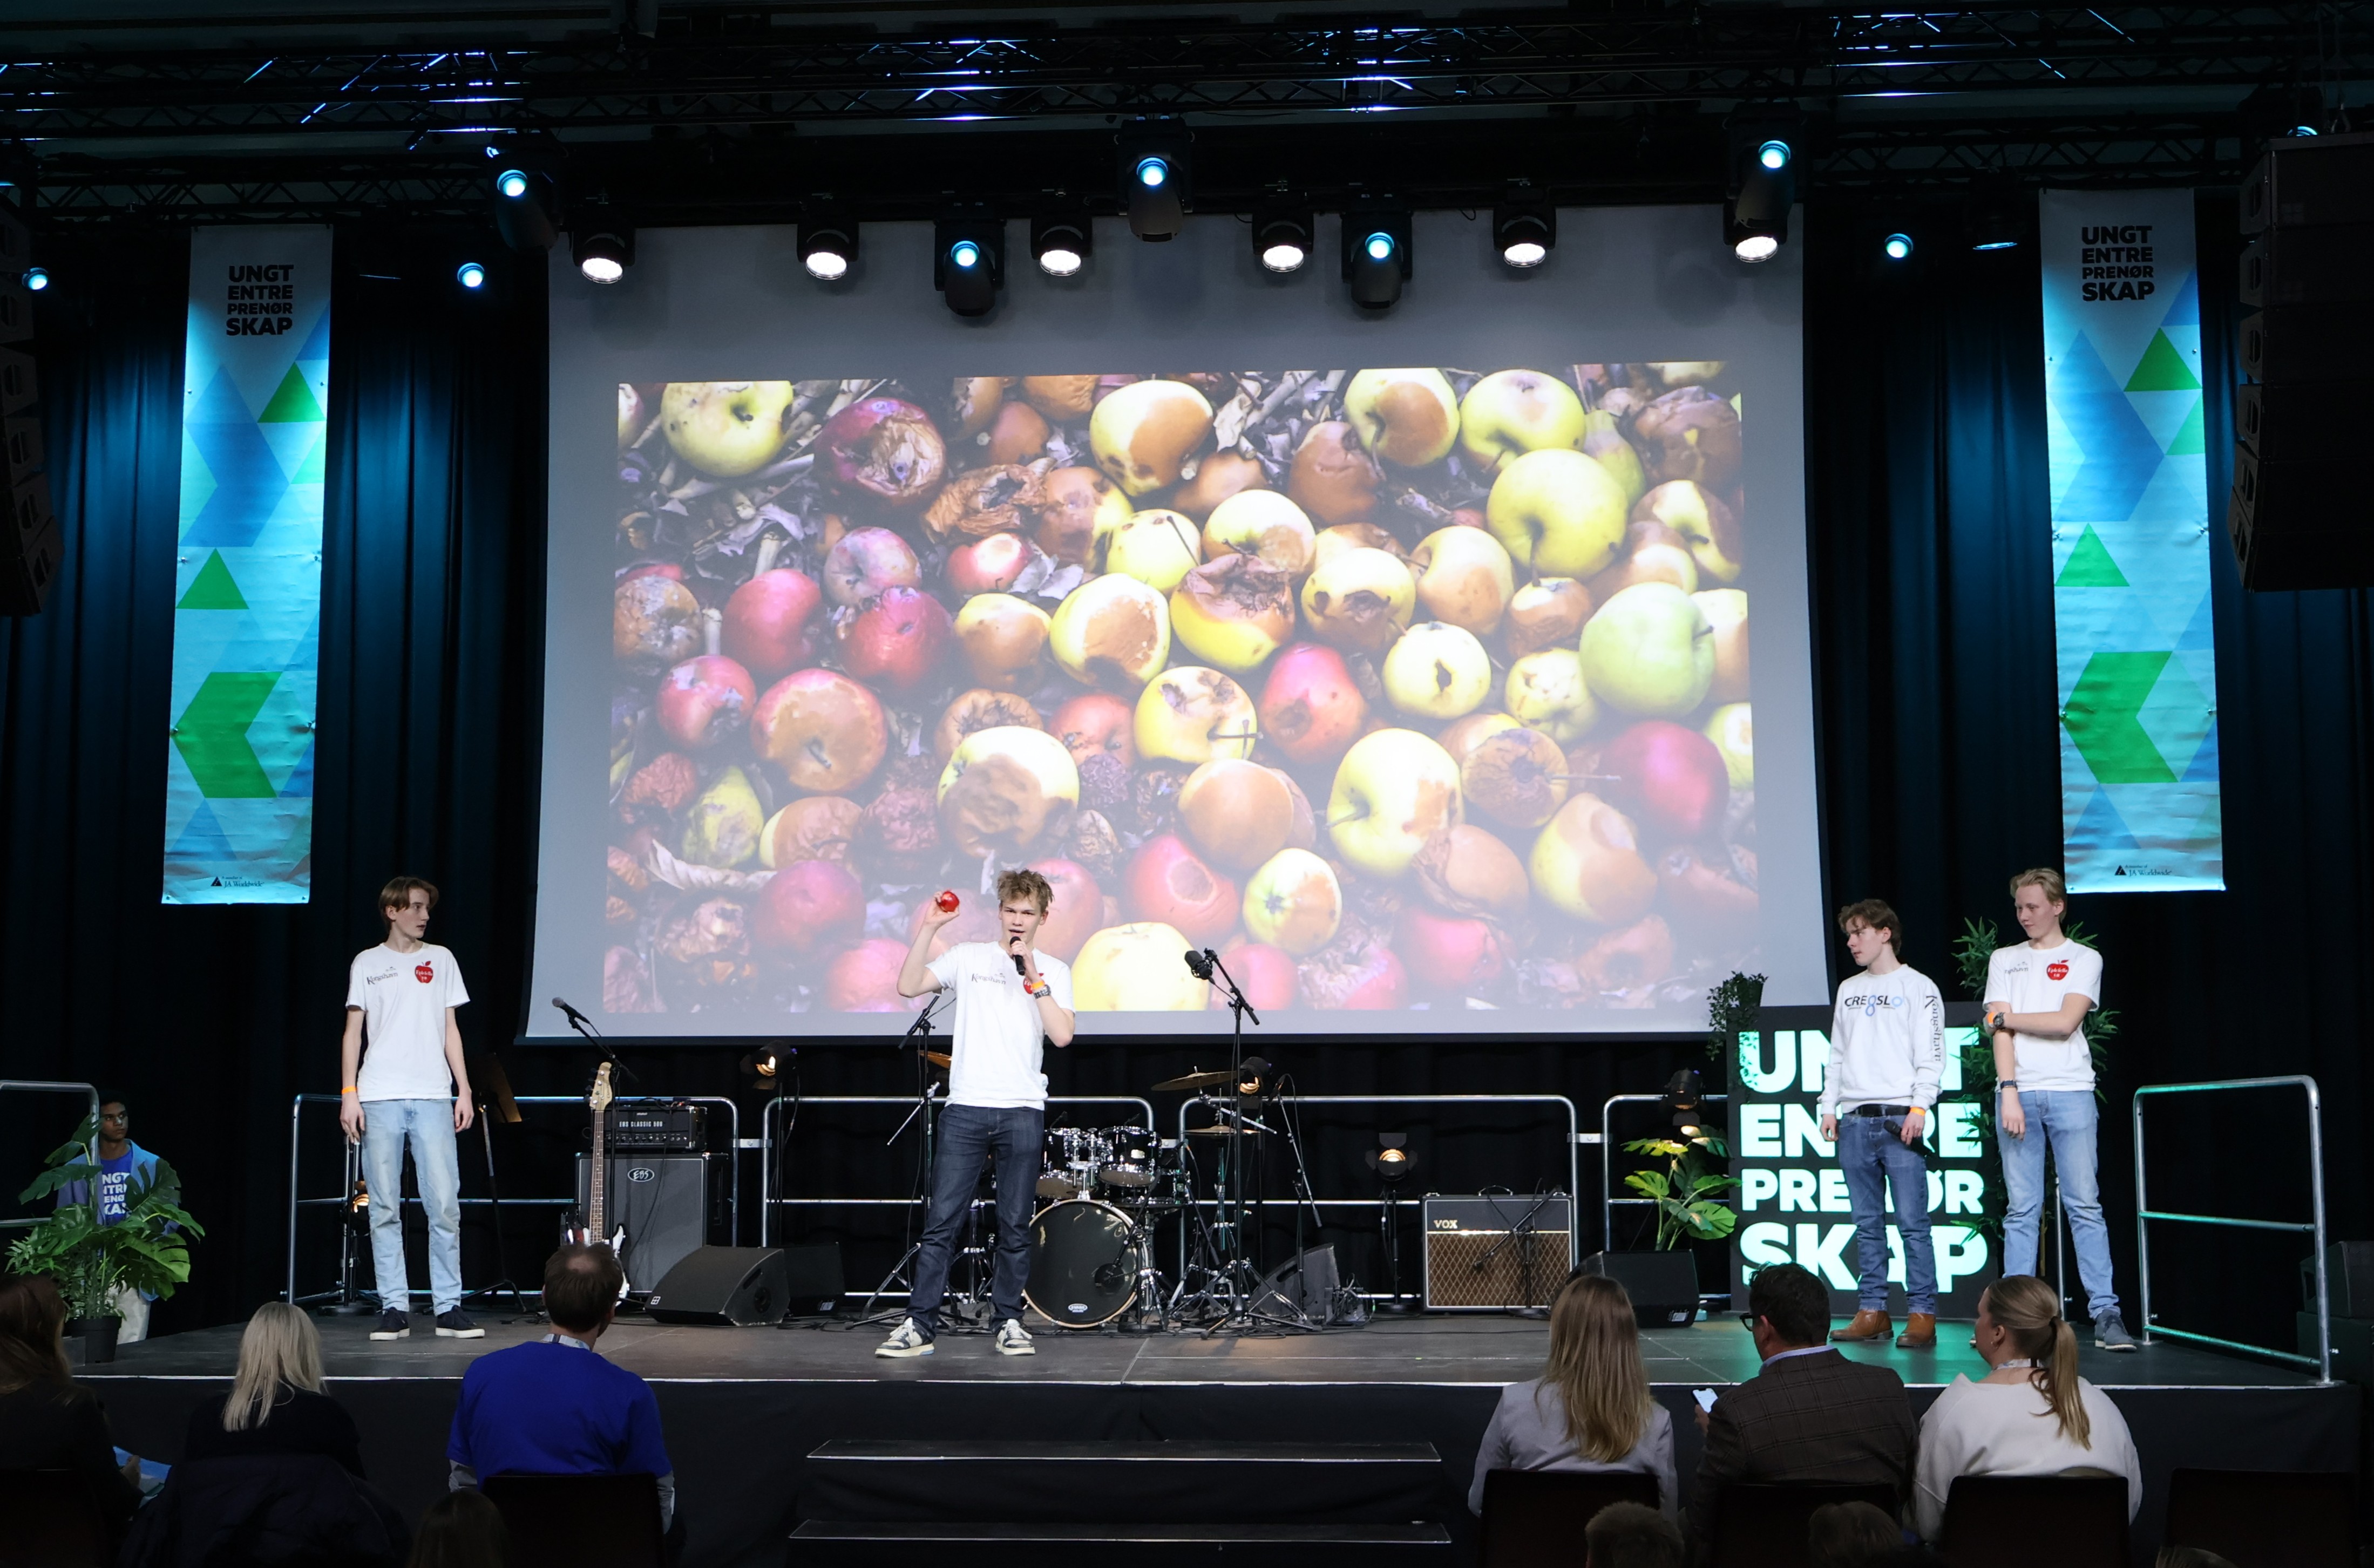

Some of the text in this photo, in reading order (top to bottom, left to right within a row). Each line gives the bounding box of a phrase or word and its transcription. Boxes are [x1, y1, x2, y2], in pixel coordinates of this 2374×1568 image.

[2082, 225, 2153, 245] UNGT
[2081, 247, 2153, 264] ENTRE
[229, 264, 294, 283] UNGT
[2082, 266, 2154, 280] PRENØR
[228, 284, 294, 300] ENTRE
[2082, 281, 2155, 302] SKAP
[227, 302, 293, 315] PRENØR
[226, 317, 293, 336] SKAP
[971, 973, 1006, 985] Kongshavn
[1924, 995, 1942, 1062] Kongshavn
[102, 1172, 130, 1185] NGT
[633, 1170, 649, 1180] EBS
[1434, 1219, 1458, 1229] VOX
